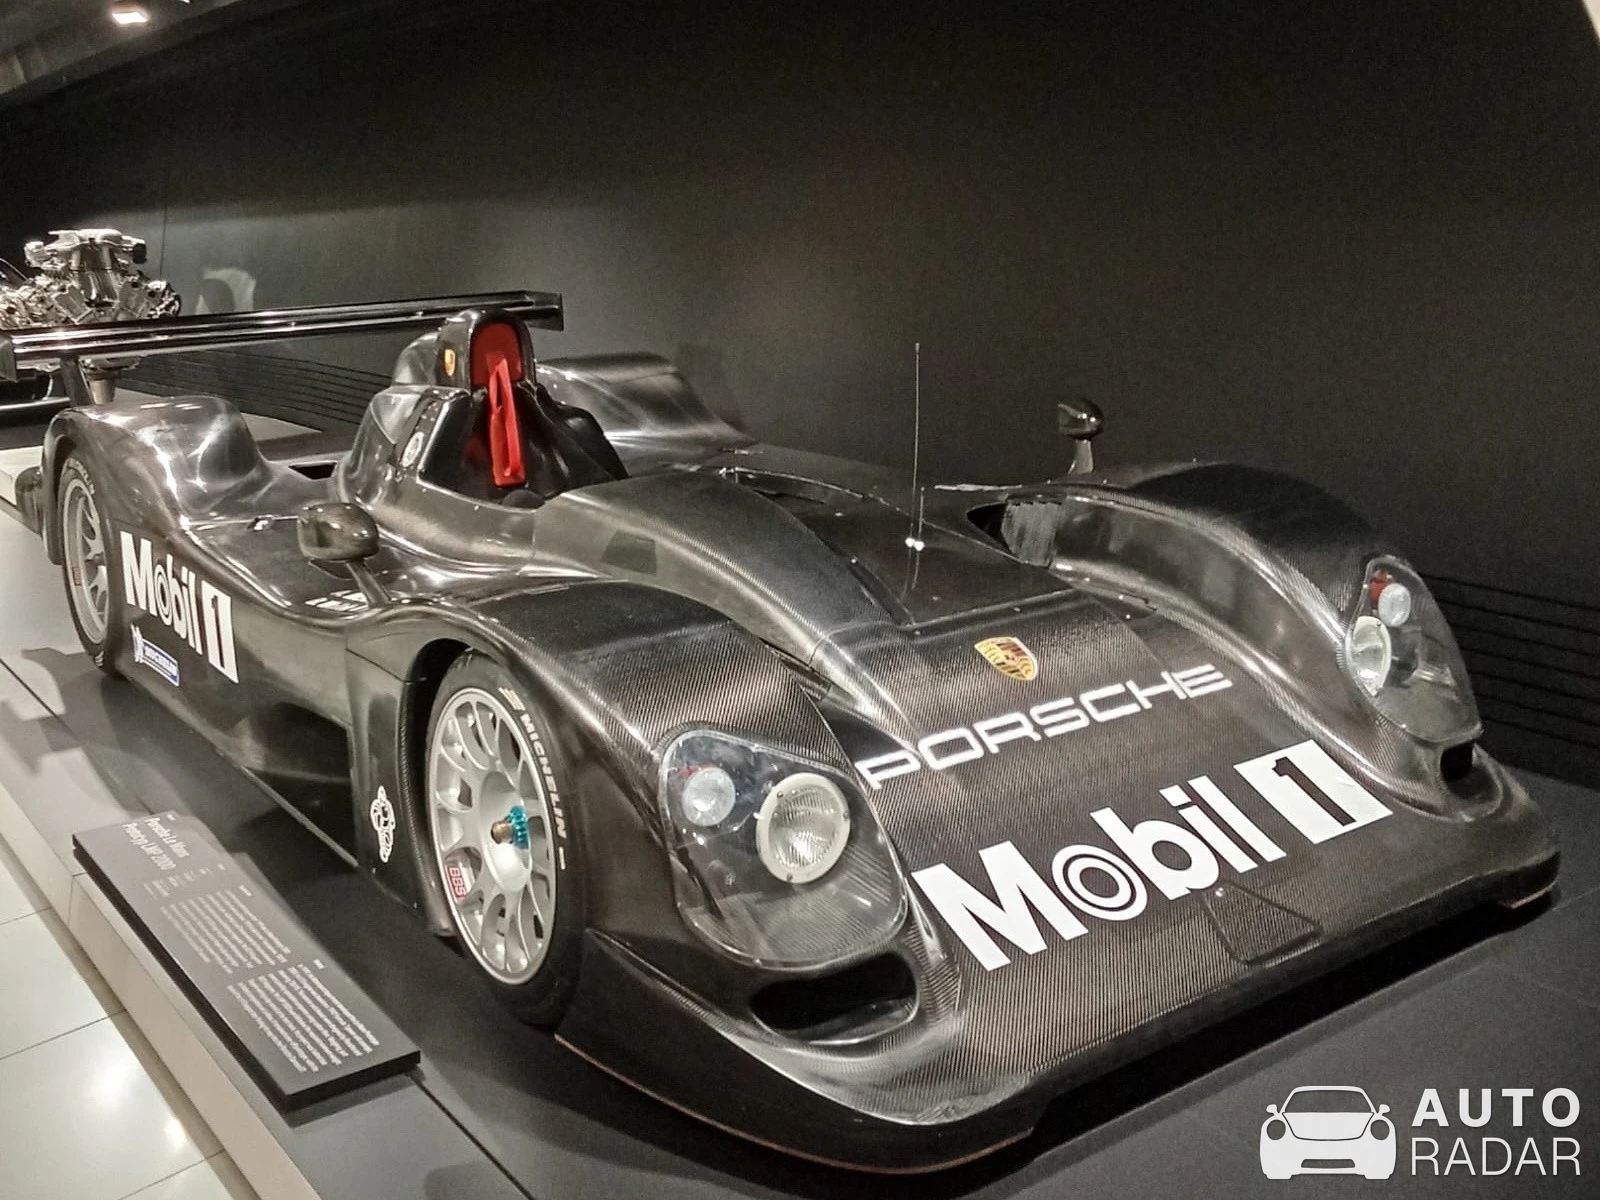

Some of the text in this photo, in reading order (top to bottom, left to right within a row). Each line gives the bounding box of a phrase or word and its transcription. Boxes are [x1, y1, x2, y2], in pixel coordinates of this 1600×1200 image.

[120, 531, 203, 655] Mobil
[520, 713, 567, 839] MICHELIN
[854, 663, 1233, 790] PORSCHE
[449, 867, 467, 896] BBS
[911, 775, 1288, 972] Mobil
